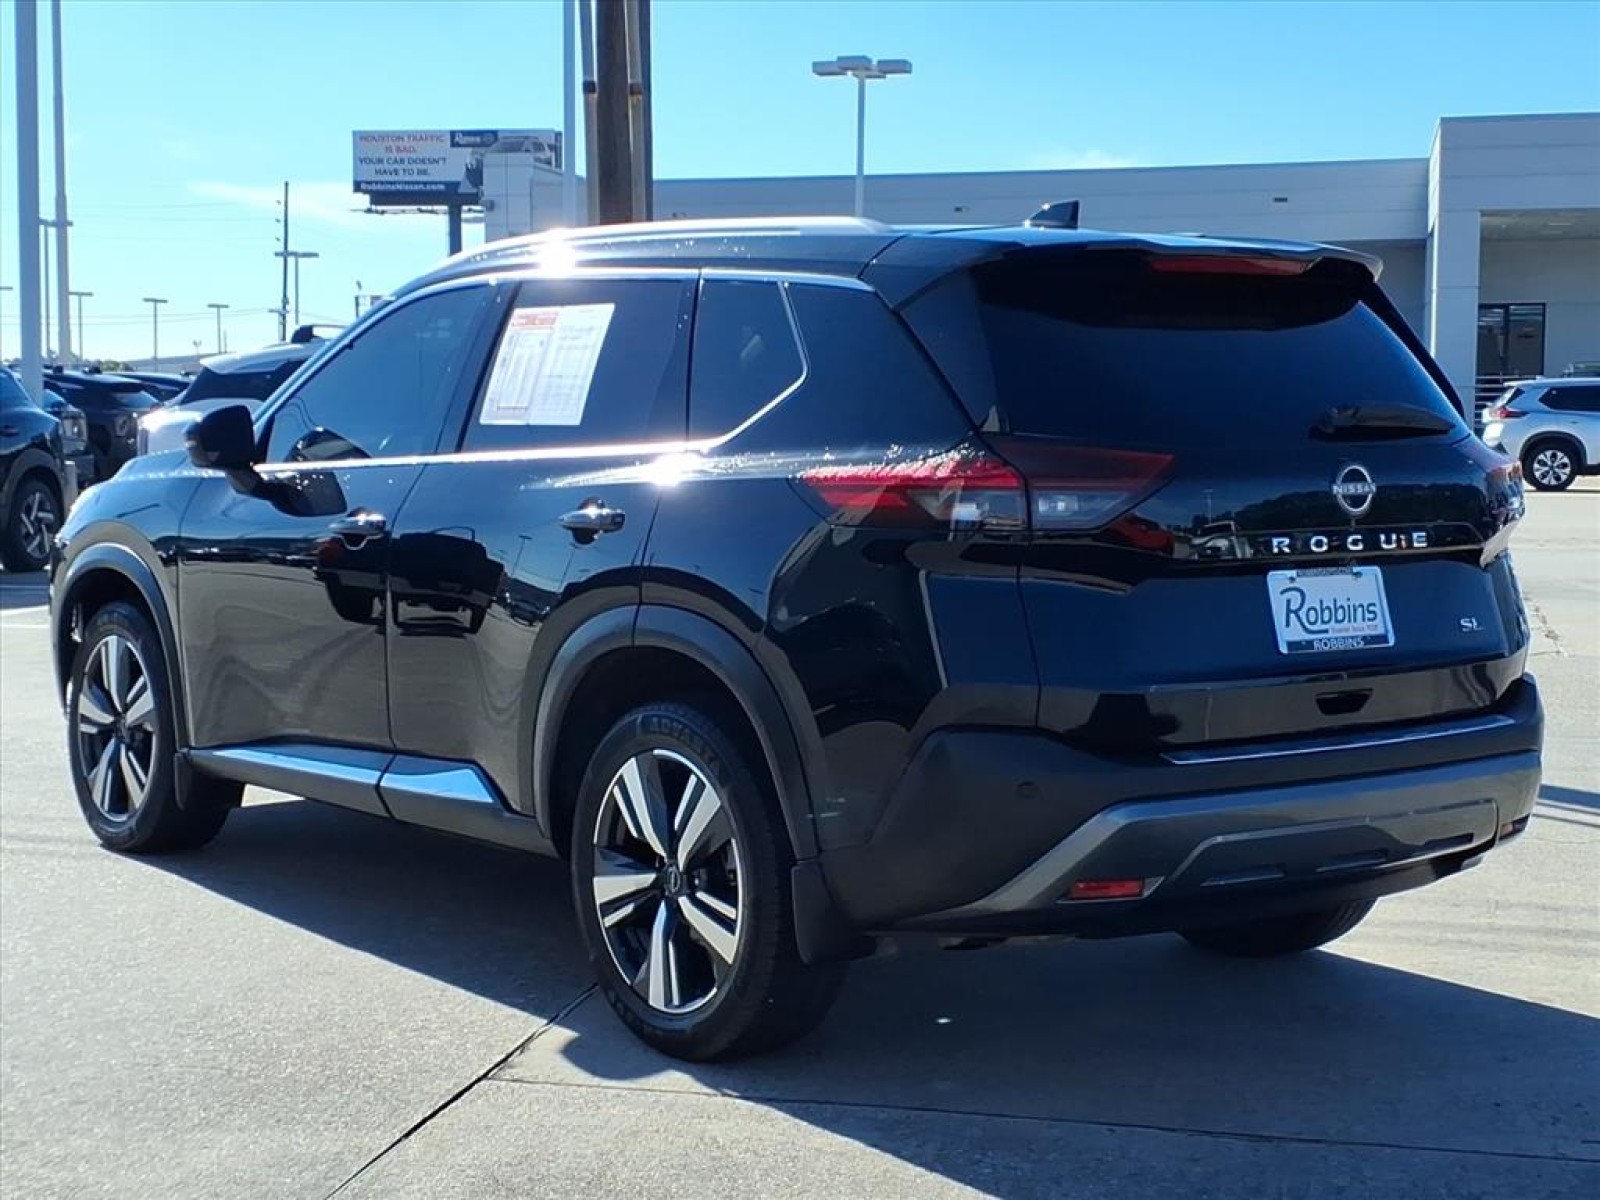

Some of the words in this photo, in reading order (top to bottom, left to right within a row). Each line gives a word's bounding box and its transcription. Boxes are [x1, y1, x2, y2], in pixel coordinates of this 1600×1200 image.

[359, 135, 404, 143] HOUSTON
[406, 135, 445, 143] TRAFFIC
[359, 157, 384, 165] YOUR
[386, 157, 405, 165] CAR
[407, 157, 447, 165] DOESN'T
[375, 168, 399, 176] HAVE
[402, 168, 415, 176] TO
[1332, 483, 1376, 495] NISSAN
[1271, 532, 1428, 553] ROGUE
[1279, 586, 1378, 635] Robbins
[1460, 618, 1484, 631] SL
[1313, 637, 1365, 651] ROBBINS
